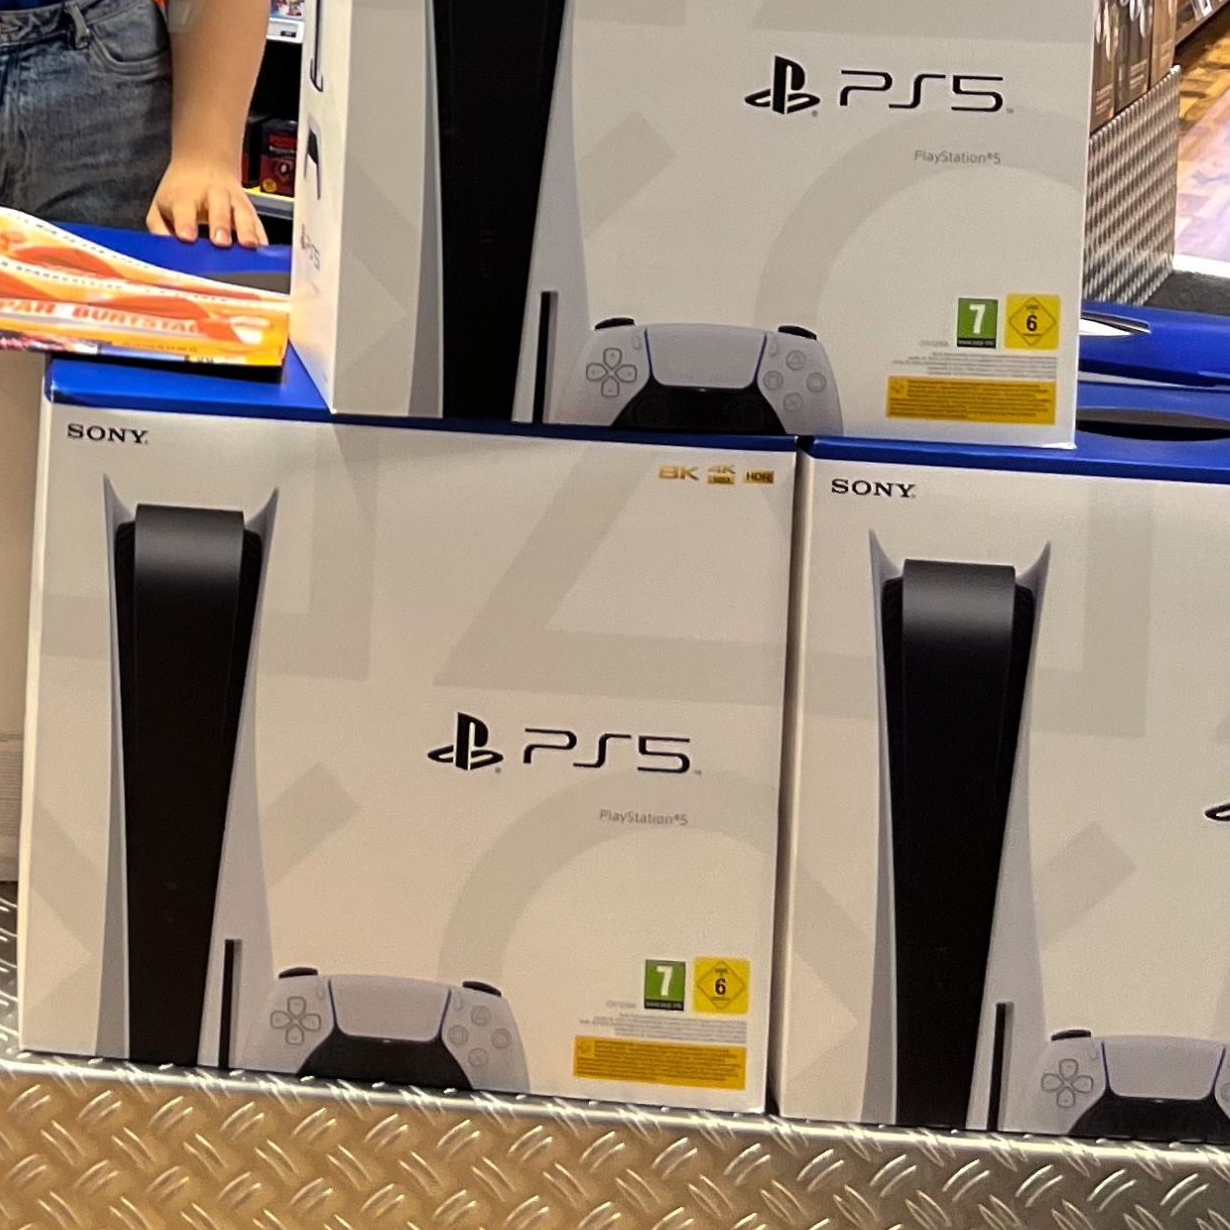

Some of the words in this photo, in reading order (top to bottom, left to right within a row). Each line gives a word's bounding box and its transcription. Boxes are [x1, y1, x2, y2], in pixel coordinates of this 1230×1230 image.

[839, 69, 1004, 113] PS5
[969, 303, 986, 335] 7
[1025, 314, 1038, 332] 6
[67, 422, 149, 444] SONY
[831, 478, 916, 498] SONY
[523, 727, 691, 774] PS5
[655, 965, 673, 997] 7
[714, 977, 727, 995] 6
